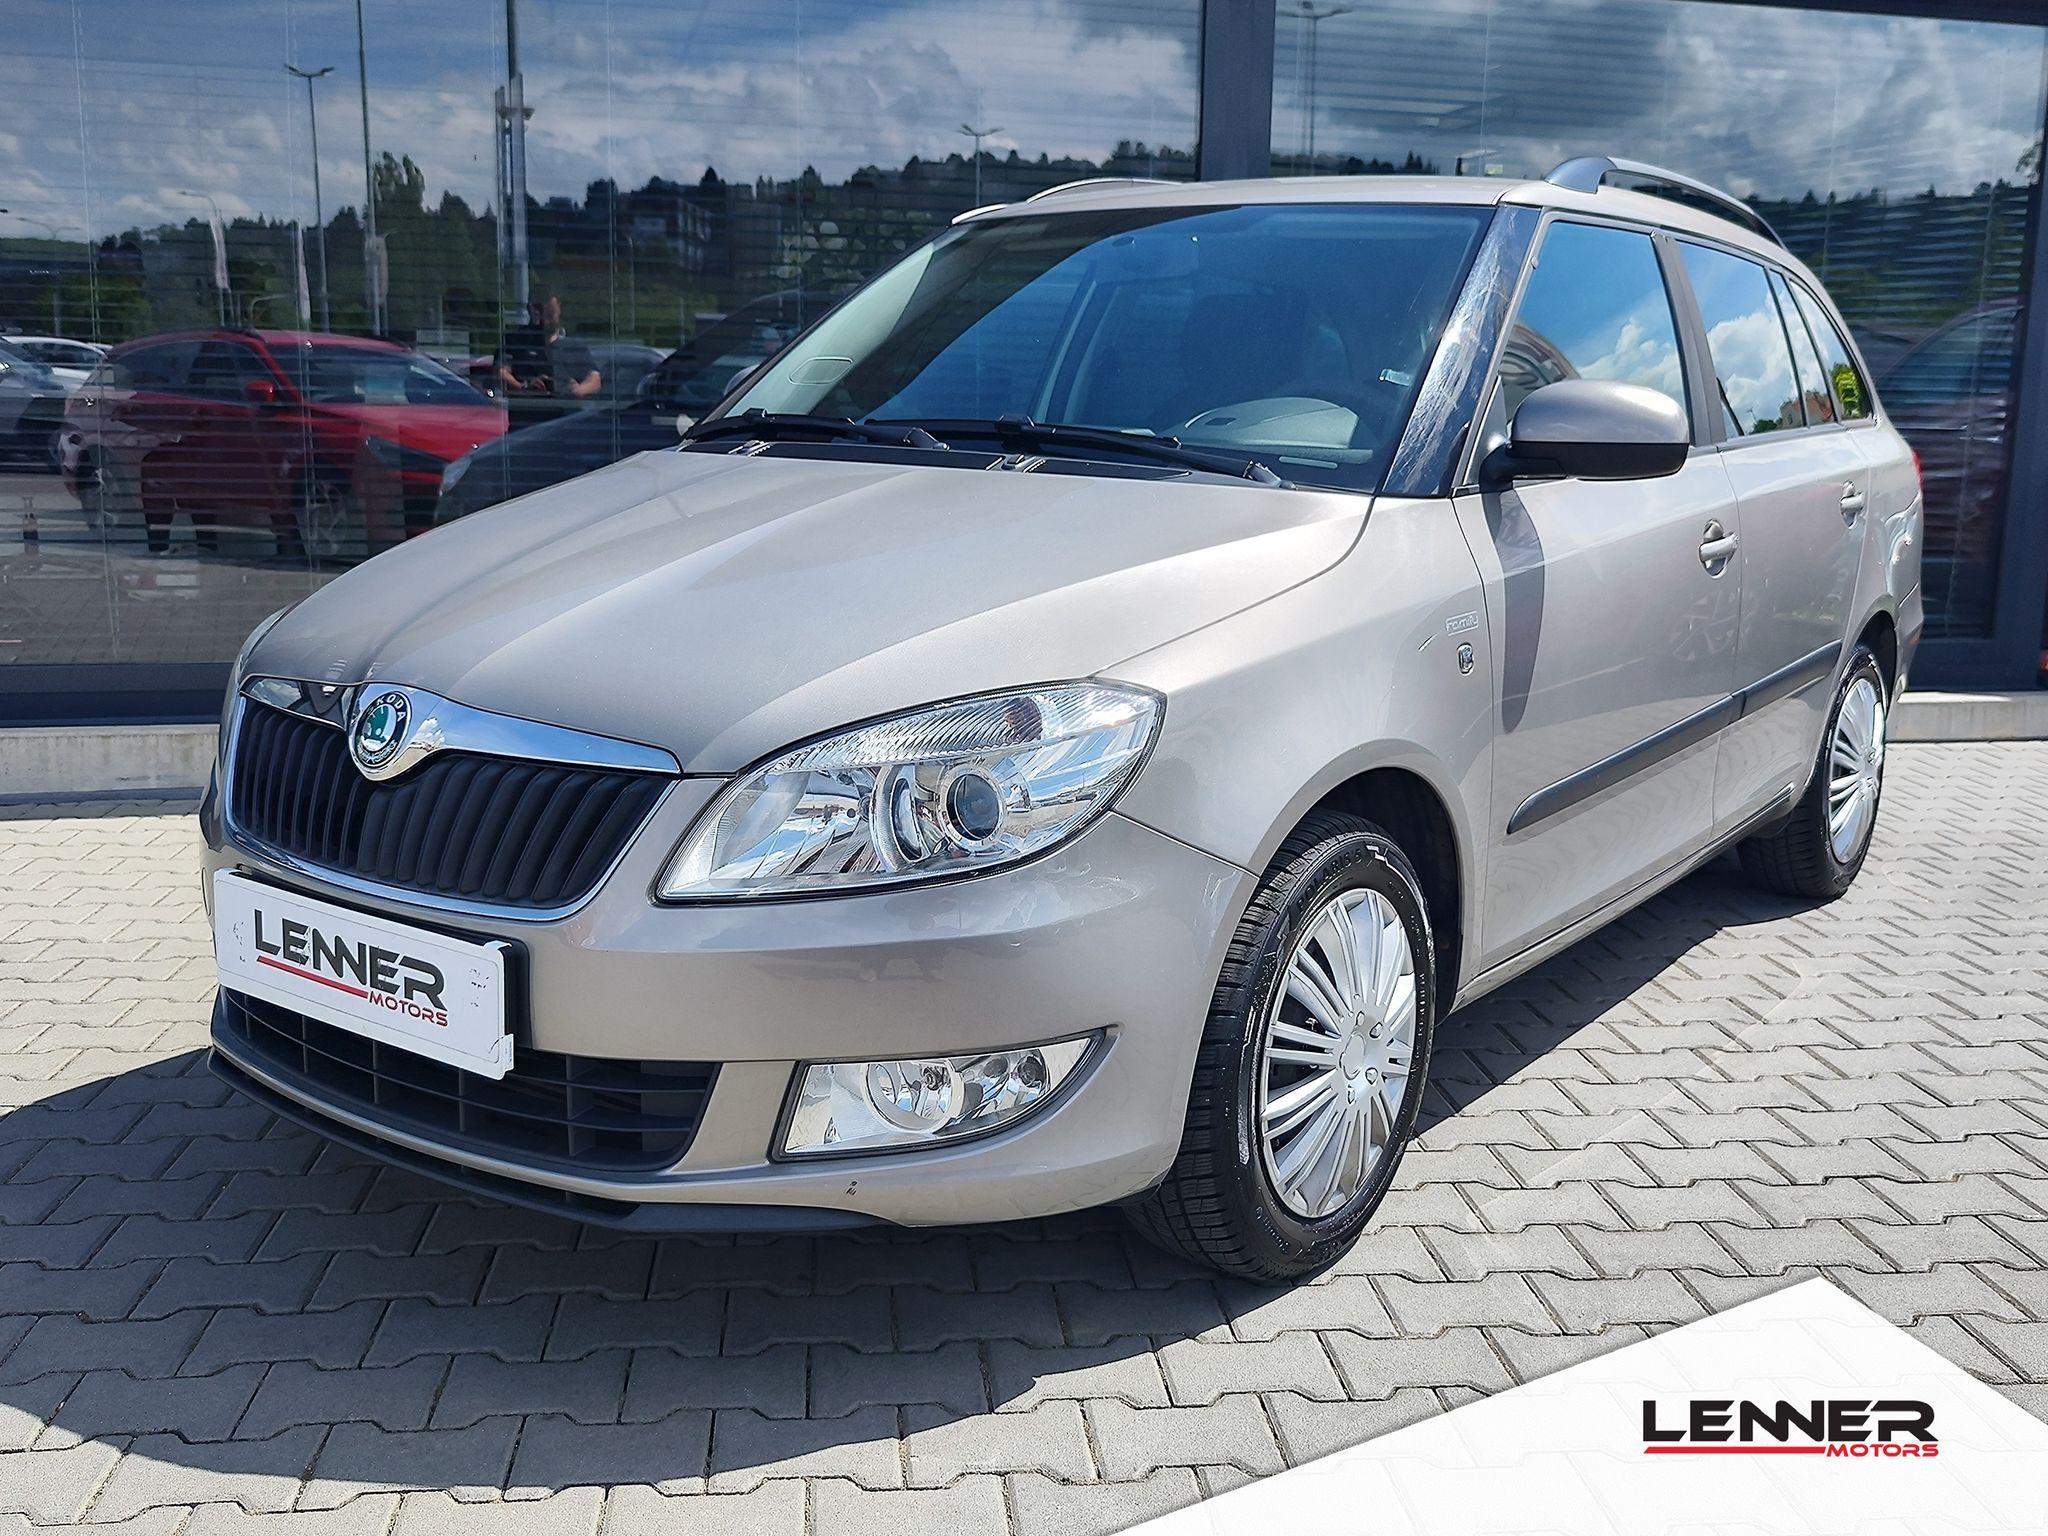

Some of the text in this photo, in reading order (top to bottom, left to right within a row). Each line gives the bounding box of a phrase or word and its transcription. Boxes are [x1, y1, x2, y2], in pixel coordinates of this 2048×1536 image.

[366, 694, 406, 722] KODA
[254, 909, 448, 1011] LENNER
[369, 990, 449, 1028] MOTORS
